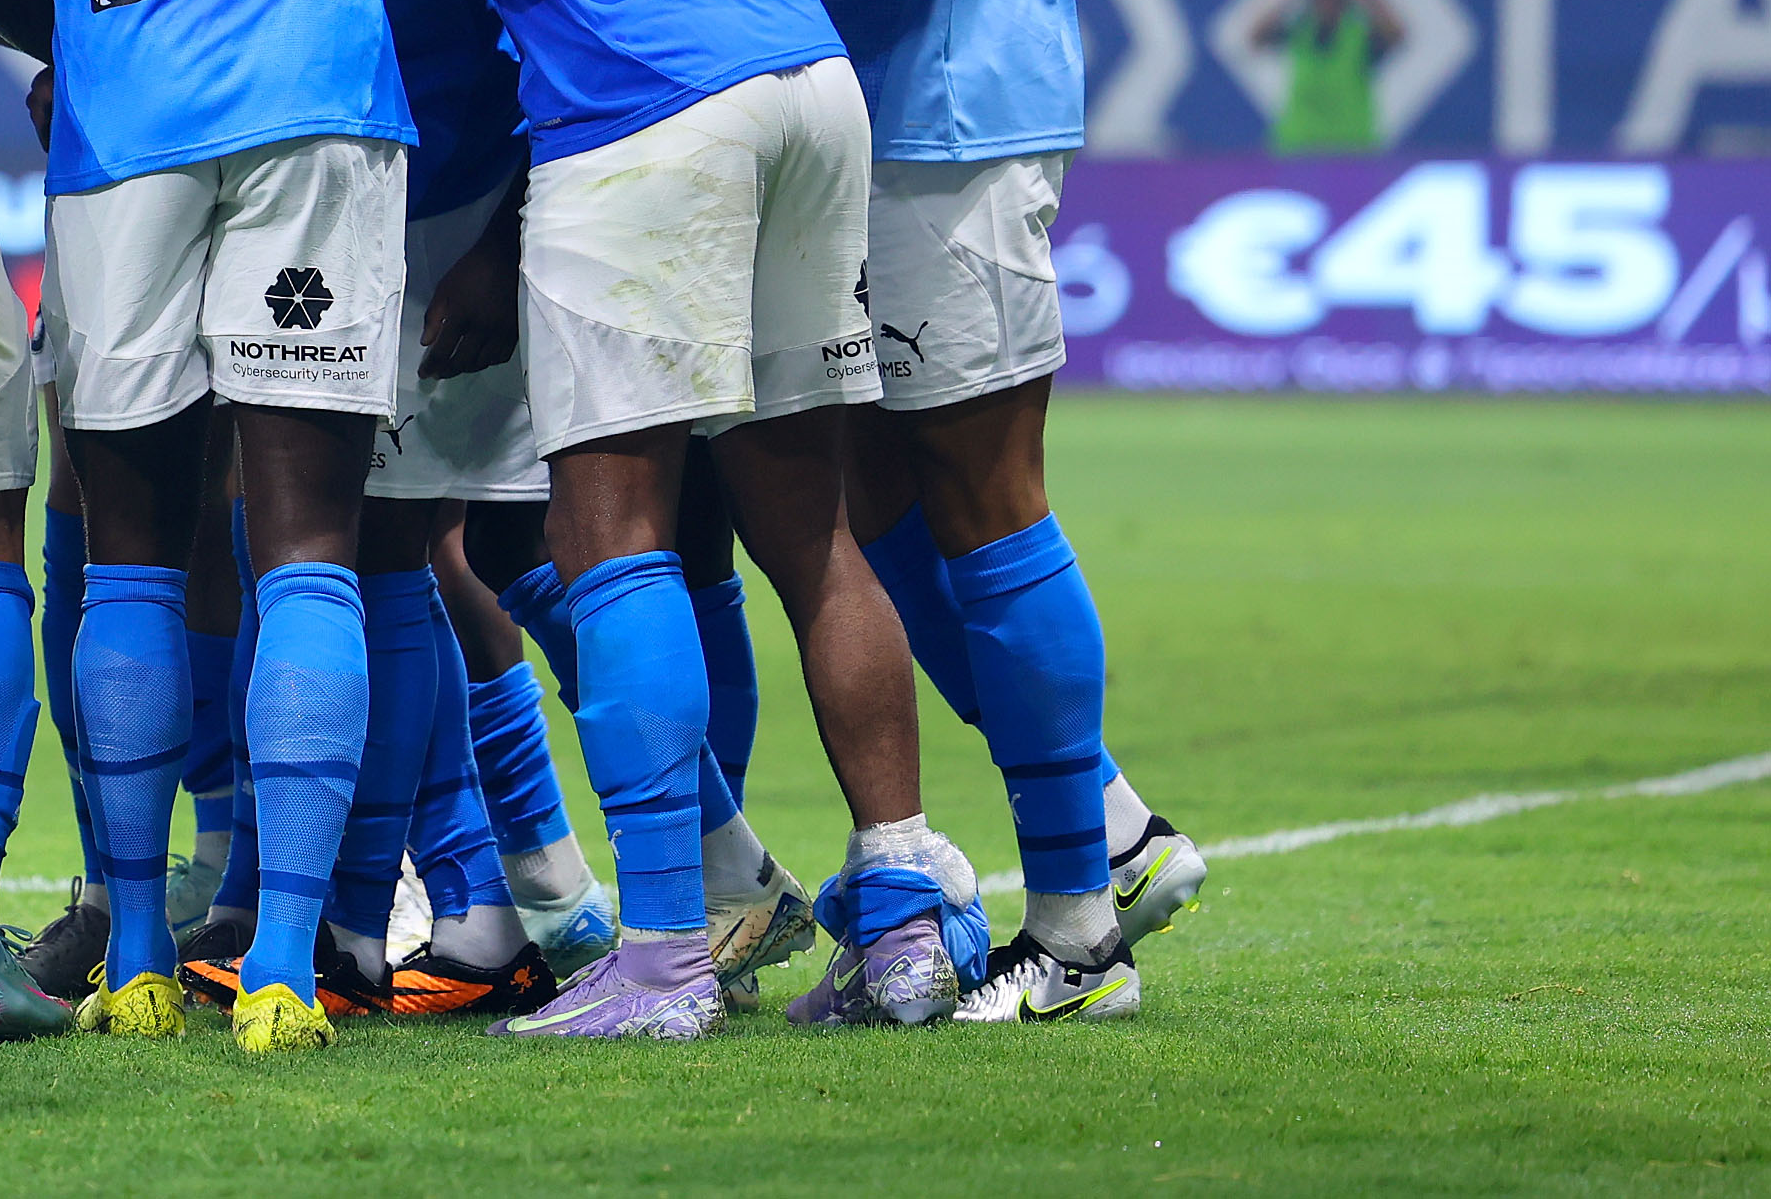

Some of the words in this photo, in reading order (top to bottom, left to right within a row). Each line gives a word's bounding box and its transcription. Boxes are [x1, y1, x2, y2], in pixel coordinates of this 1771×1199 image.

[231, 341, 367, 362] NOTHREAT
[232, 363, 319, 382] Cybersecurity
[323, 368, 369, 381] Partner
